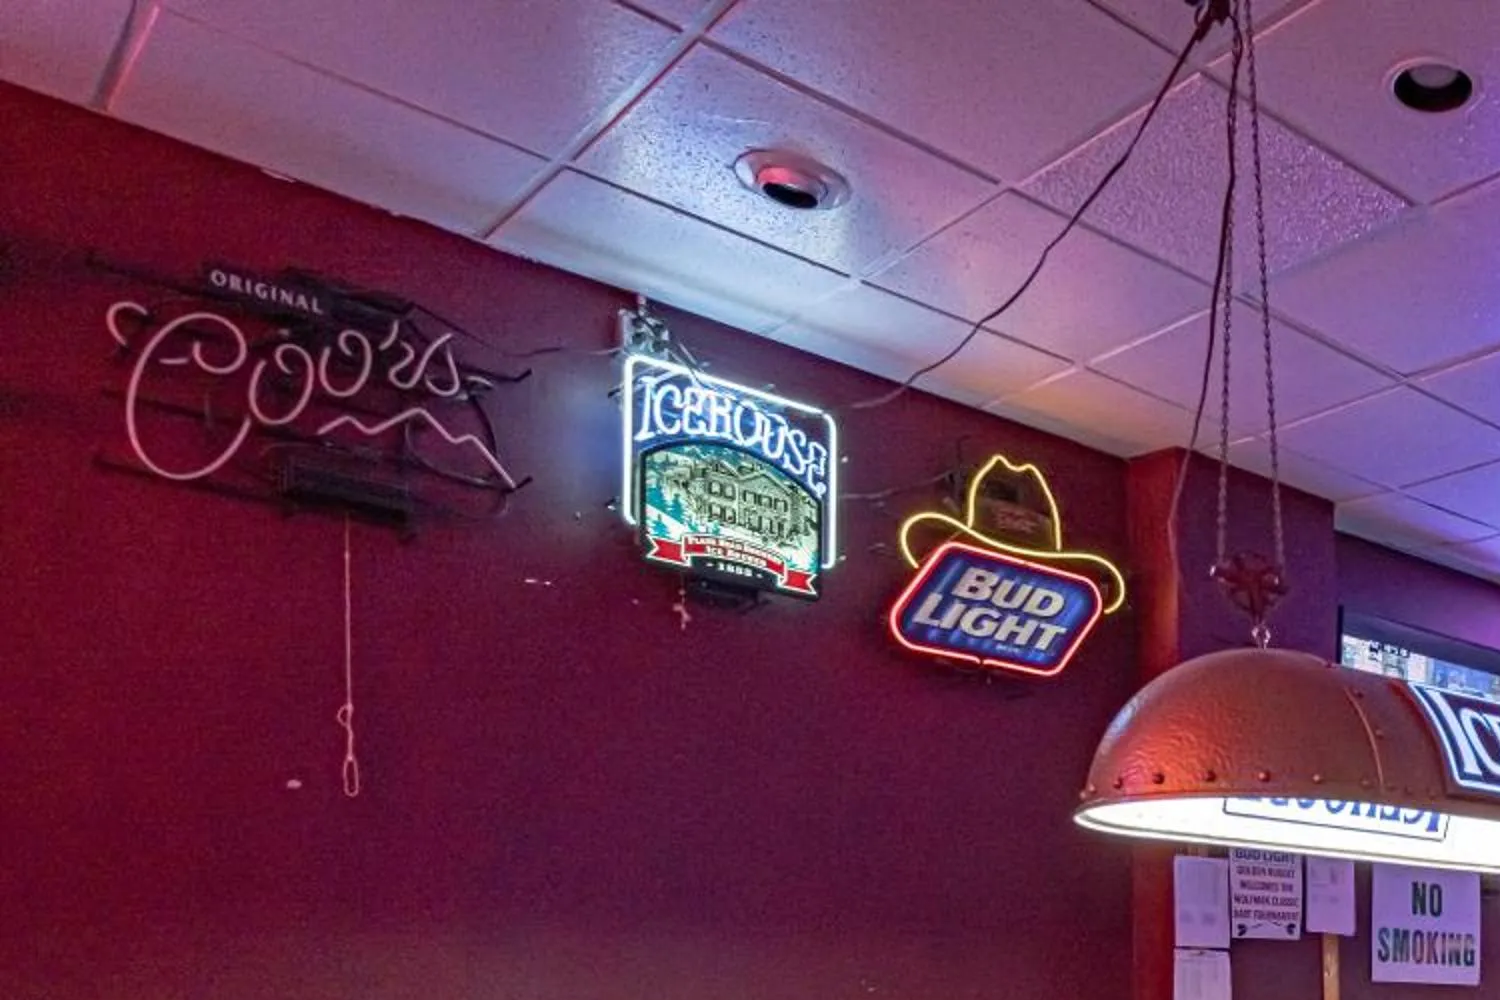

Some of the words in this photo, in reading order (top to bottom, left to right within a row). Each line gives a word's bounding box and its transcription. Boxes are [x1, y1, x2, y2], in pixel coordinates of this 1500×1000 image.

[210, 268, 324, 315] ORIGINAL
[633, 374, 828, 499] ICEHOUSE
[951, 566, 1065, 618] BUD
[911, 592, 1067, 650] LIGHT
[1411, 880, 1443, 918] NO
[1376, 926, 1476, 967] SMOKING
